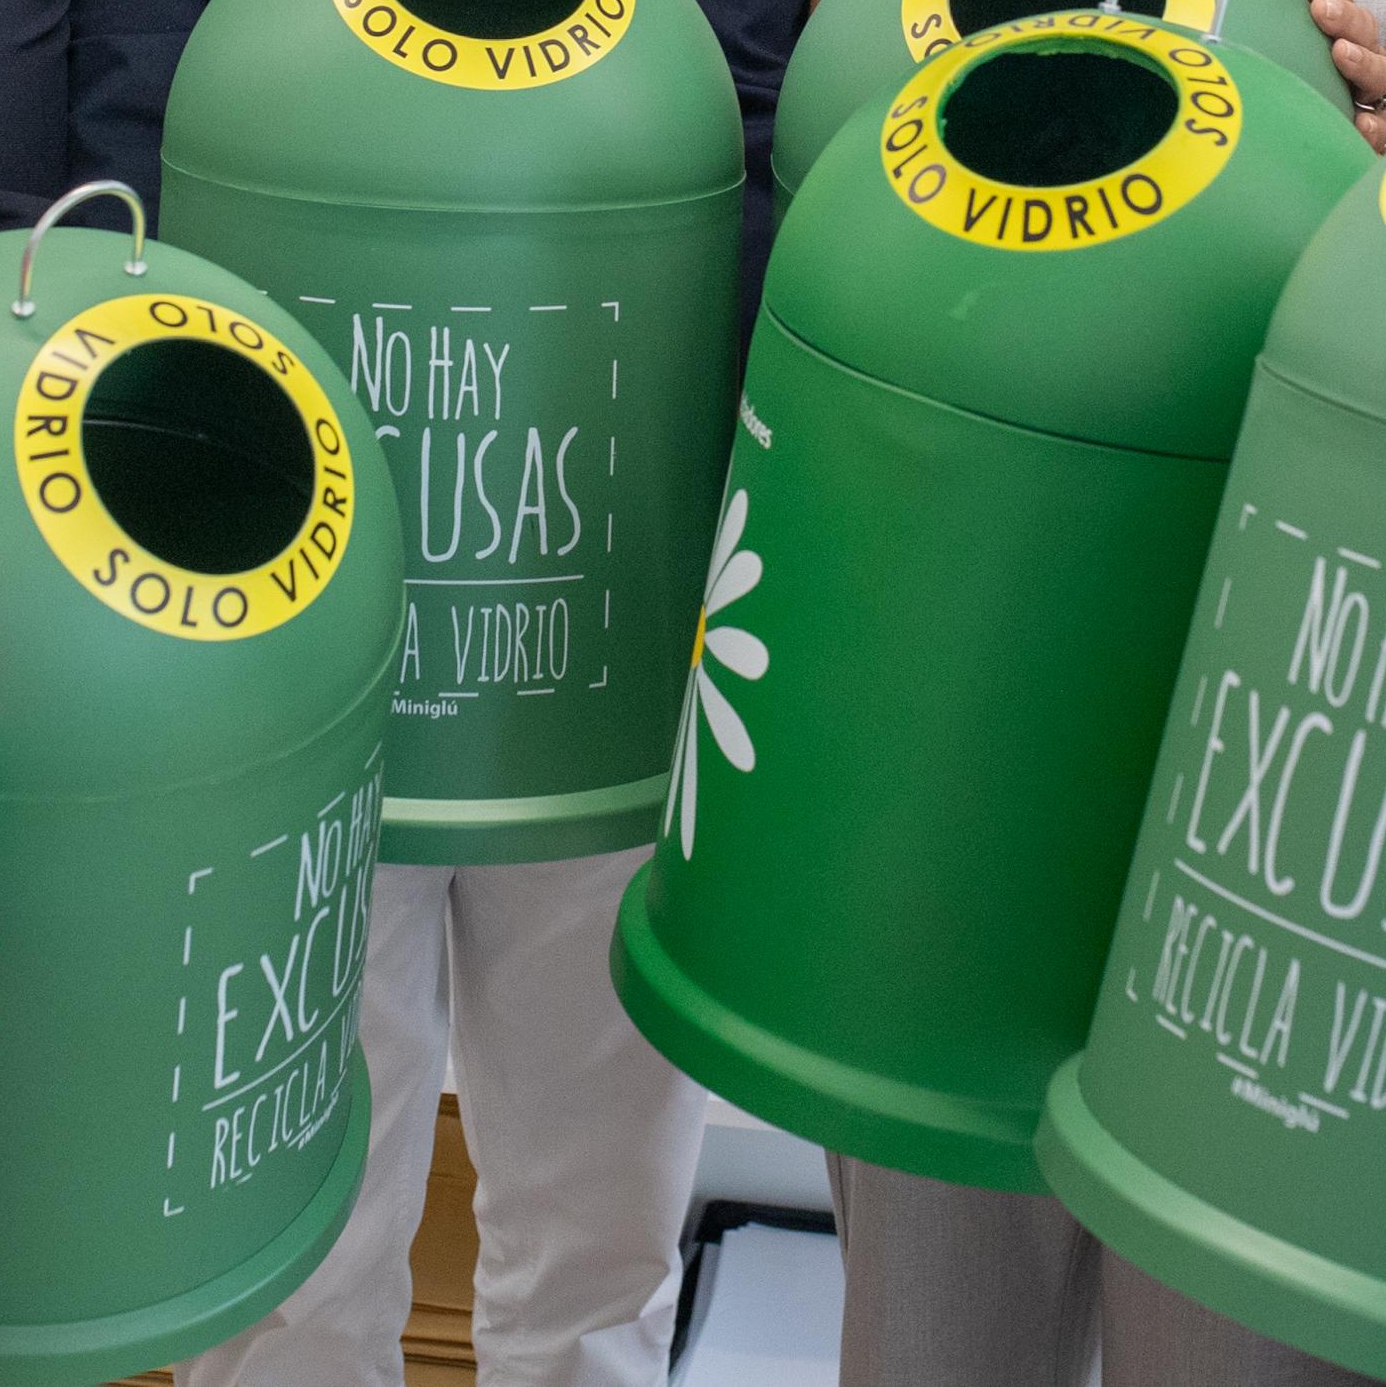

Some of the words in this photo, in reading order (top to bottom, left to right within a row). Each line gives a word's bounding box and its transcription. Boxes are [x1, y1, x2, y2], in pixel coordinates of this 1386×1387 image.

[886, 95, 947, 204] SOLO
[962, 172, 1163, 243] VIDRIO
[1168, 48, 1235, 147] SOLO
[149, 300, 295, 376] SOLO
[351, 313, 412, 417] NO
[428, 326, 510, 421] HAY
[27, 327, 116, 515] VIDRIO
[93, 546, 249, 629] SOLO
[270, 417, 351, 603] VIDRIO
[376, 425, 582, 564] USAS
[450, 597, 570, 685] VIDRIO
[1288, 555, 1369, 708] NO
[294, 820, 342, 921] NO
[1156, 895, 1301, 1070] RECICLA
[210, 1038, 329, 1190] RECICLA
